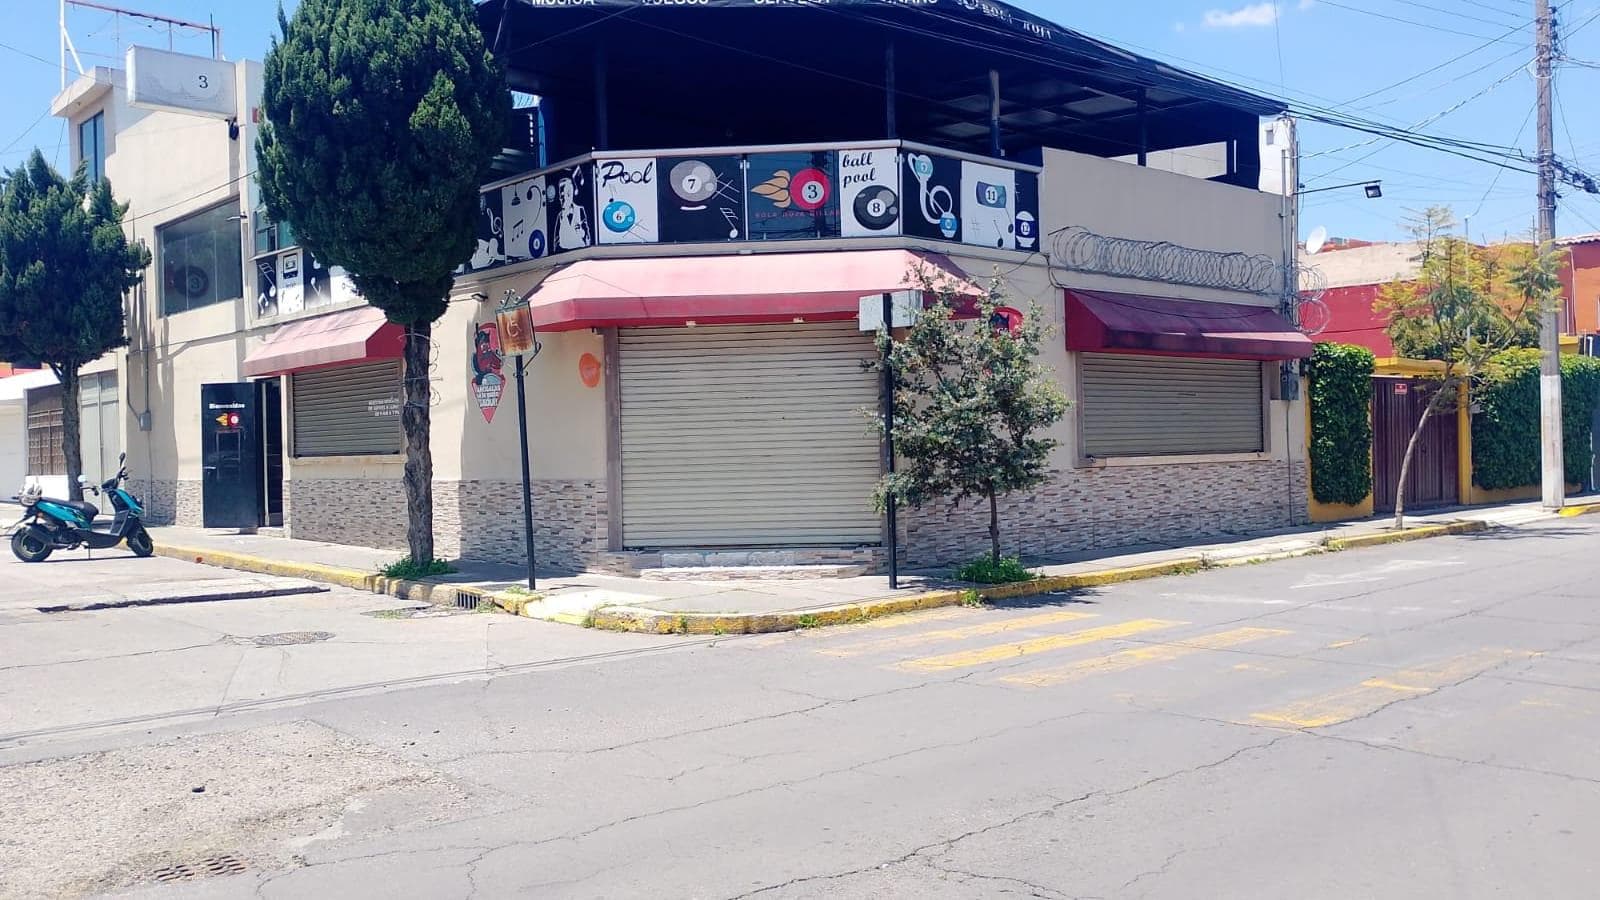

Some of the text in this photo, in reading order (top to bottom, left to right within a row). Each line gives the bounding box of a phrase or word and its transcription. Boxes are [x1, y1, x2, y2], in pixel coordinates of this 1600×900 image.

[198, 75, 209, 89] 3
[842, 151, 873, 169] ball
[601, 160, 654, 187] Pool
[842, 168, 876, 188] pool
[687, 179, 697, 190] 7
[807, 184, 819, 200] 3
[987, 190, 996, 201] 11
[872, 202, 881, 214] 8
[616, 212, 623, 221] 6
